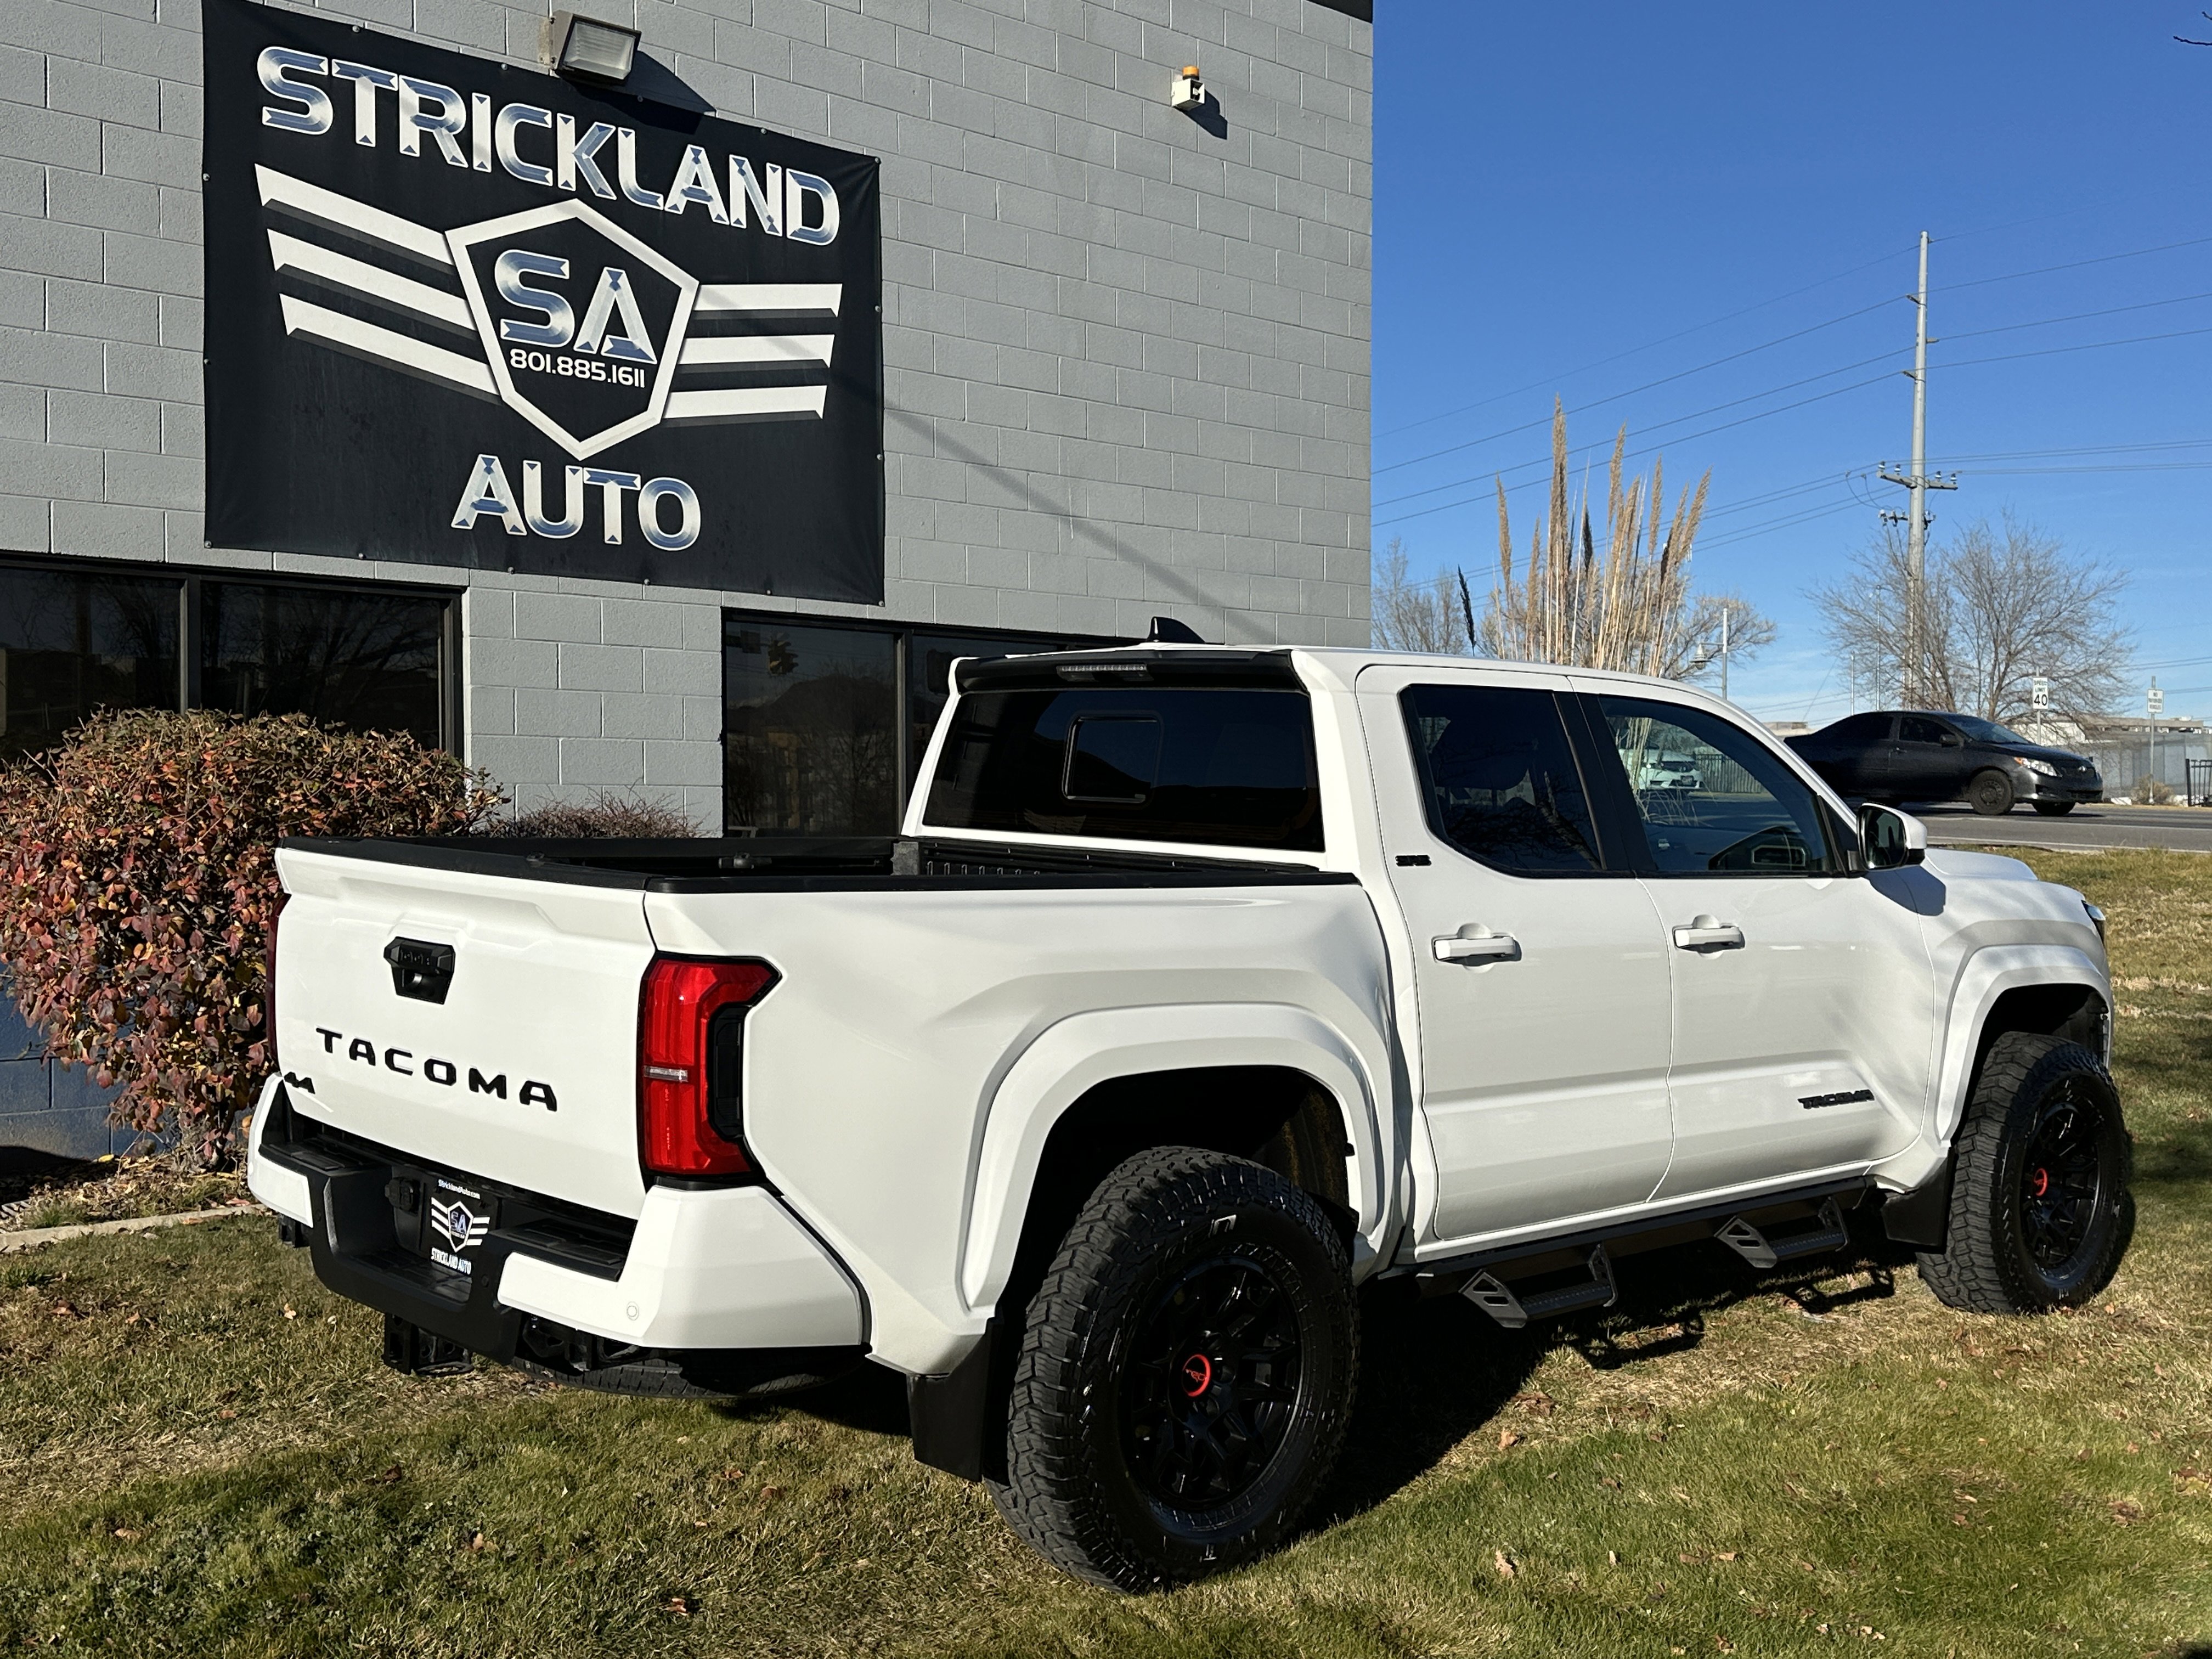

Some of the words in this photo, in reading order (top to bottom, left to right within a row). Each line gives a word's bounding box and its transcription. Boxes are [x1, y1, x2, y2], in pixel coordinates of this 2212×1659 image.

[256, 46, 840, 246] STRICKLAND
[494, 249, 658, 364] SA
[510, 348, 645, 388] 801.885.1611
[451, 454, 701, 551] AUTO
[2034, 694, 2047, 706] 40
[315, 1026, 557, 1112] TACOMA
[459, 1259, 471, 1274] AUTO
